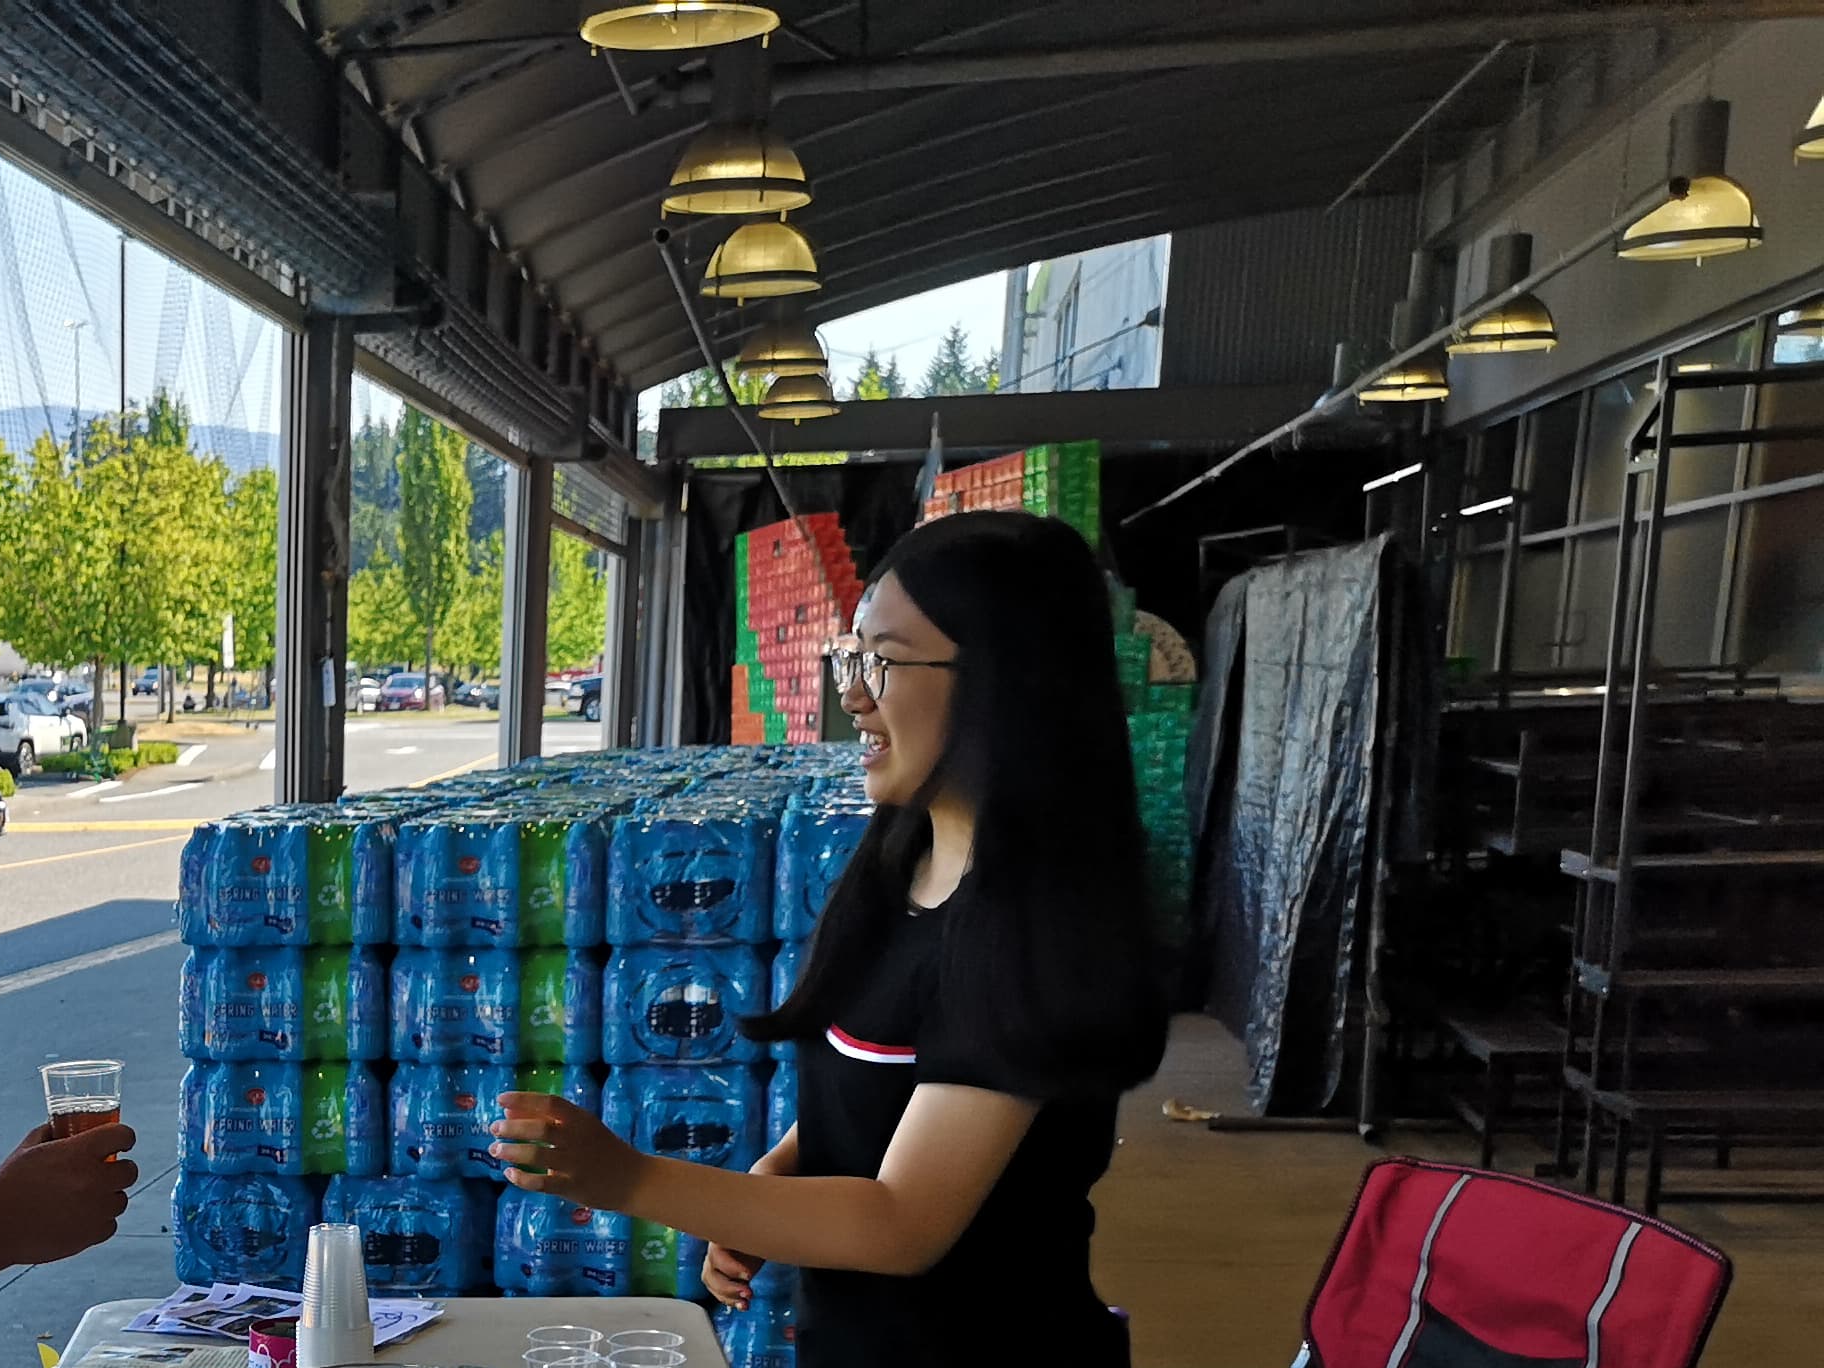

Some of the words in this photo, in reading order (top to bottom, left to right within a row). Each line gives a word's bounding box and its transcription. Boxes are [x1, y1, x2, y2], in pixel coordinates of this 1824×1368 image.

[423, 1123, 464, 1137] SPRING
[536, 1240, 579, 1254] SPRING
[585, 1240, 626, 1254] WATER
